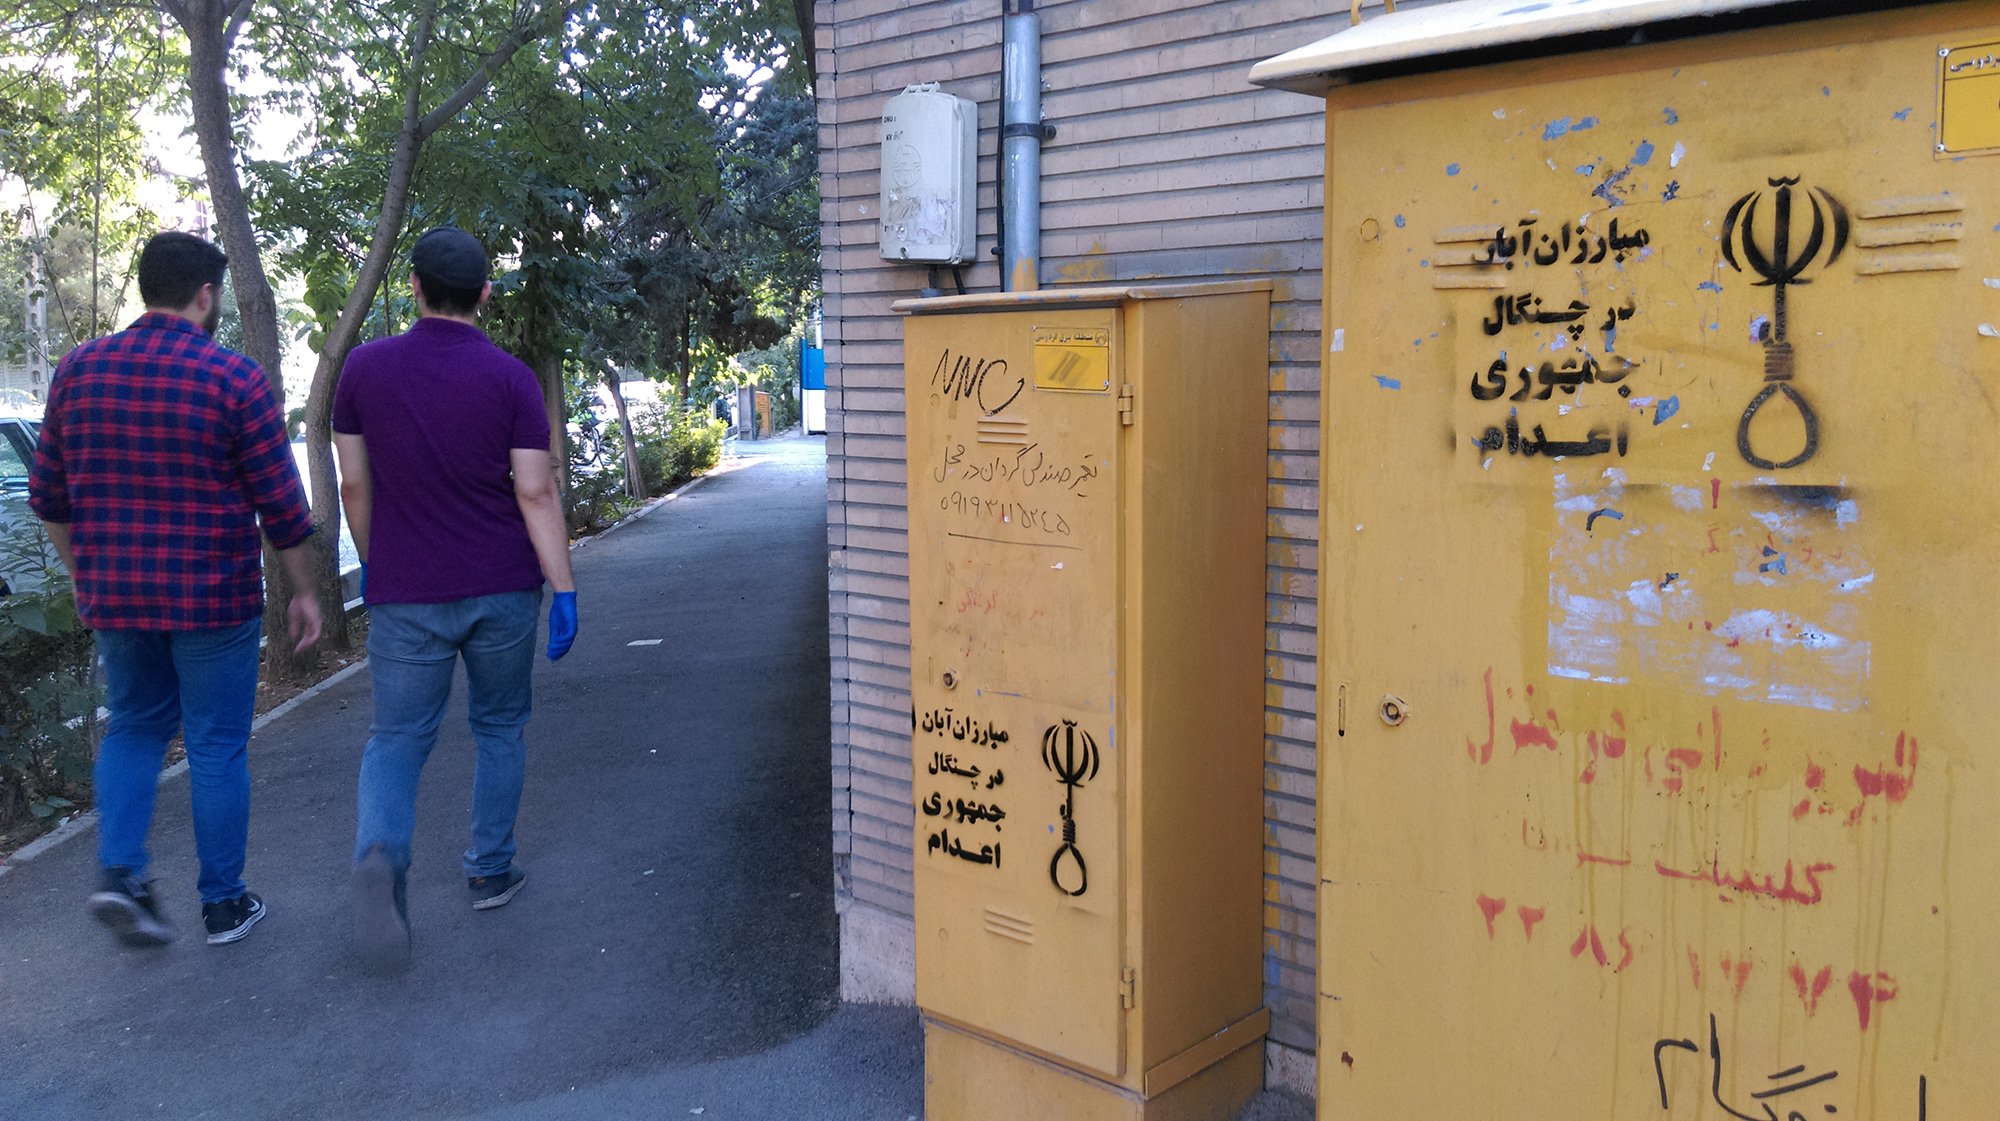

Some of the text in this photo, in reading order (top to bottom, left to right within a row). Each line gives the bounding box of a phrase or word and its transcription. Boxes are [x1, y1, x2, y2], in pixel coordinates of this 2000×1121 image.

[1949, 54, 2000, 73] ردوسی
[1533, 217, 1650, 265] مبارزان
[1483, 292, 1636, 341] در چنگال
[1470, 354, 1641, 402] جمهوری
[1478, 416, 1630, 461] اعدام
[933, 443, 966, 483] محل
[961, 464, 980, 480] در
[980, 442, 1038, 482] گردان
[1068, 453, 1098, 498] تعمیر
[922, 707, 1009, 750] مبارزان آبان
[928, 751, 1005, 790] در چنگال
[922, 791, 1007, 833] جمهوری
[928, 828, 1001, 869] اعدام
